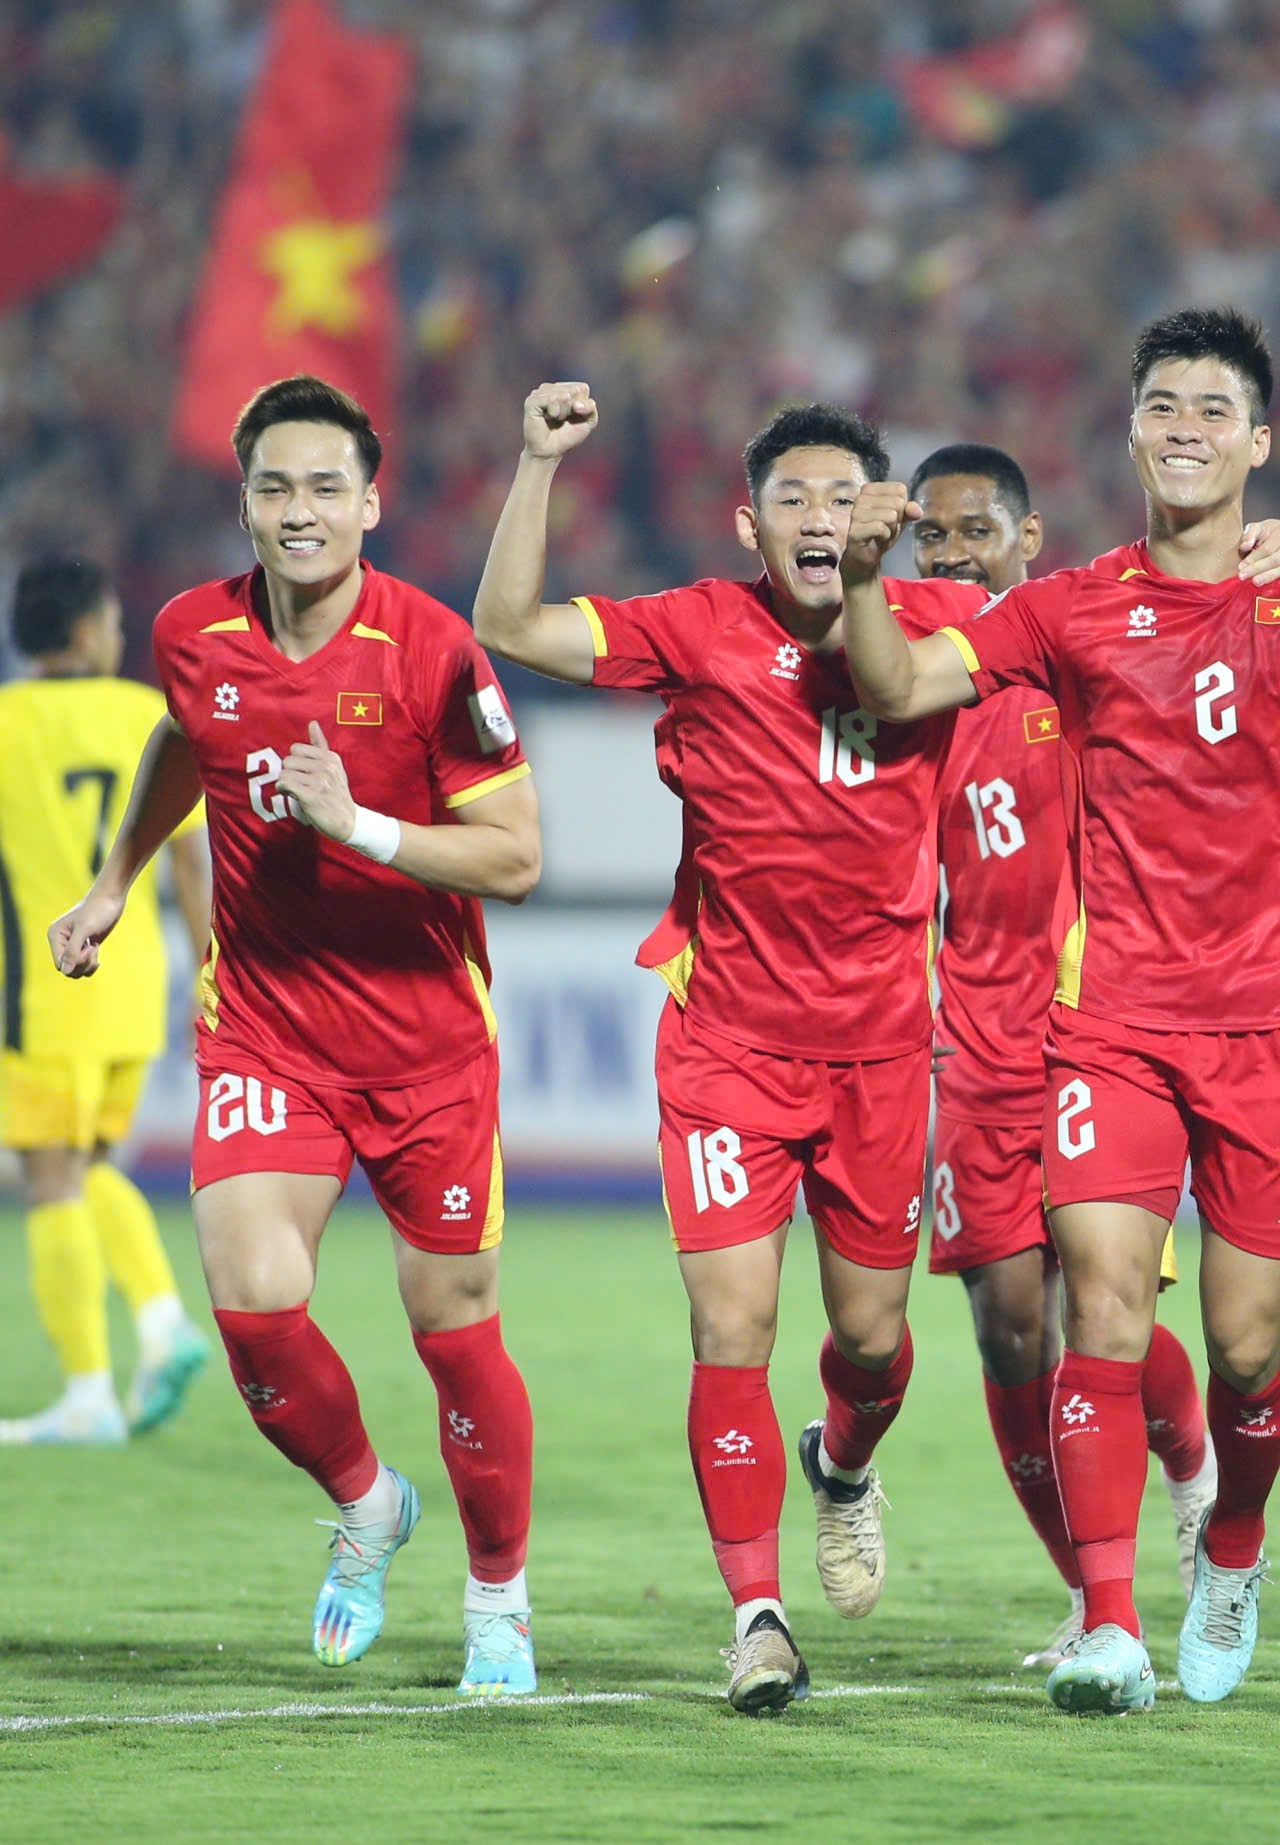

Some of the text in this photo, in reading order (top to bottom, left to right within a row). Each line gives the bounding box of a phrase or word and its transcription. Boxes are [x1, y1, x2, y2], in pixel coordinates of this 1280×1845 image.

[1195, 661, 1237, 744] 2
[818, 708, 877, 787] 18
[63, 767, 118, 878] 7
[965, 777, 1026, 860] 13
[208, 1073, 287, 1142] 20
[1058, 1078, 1095, 1160] 2
[687, 1126, 749, 1214] 18
